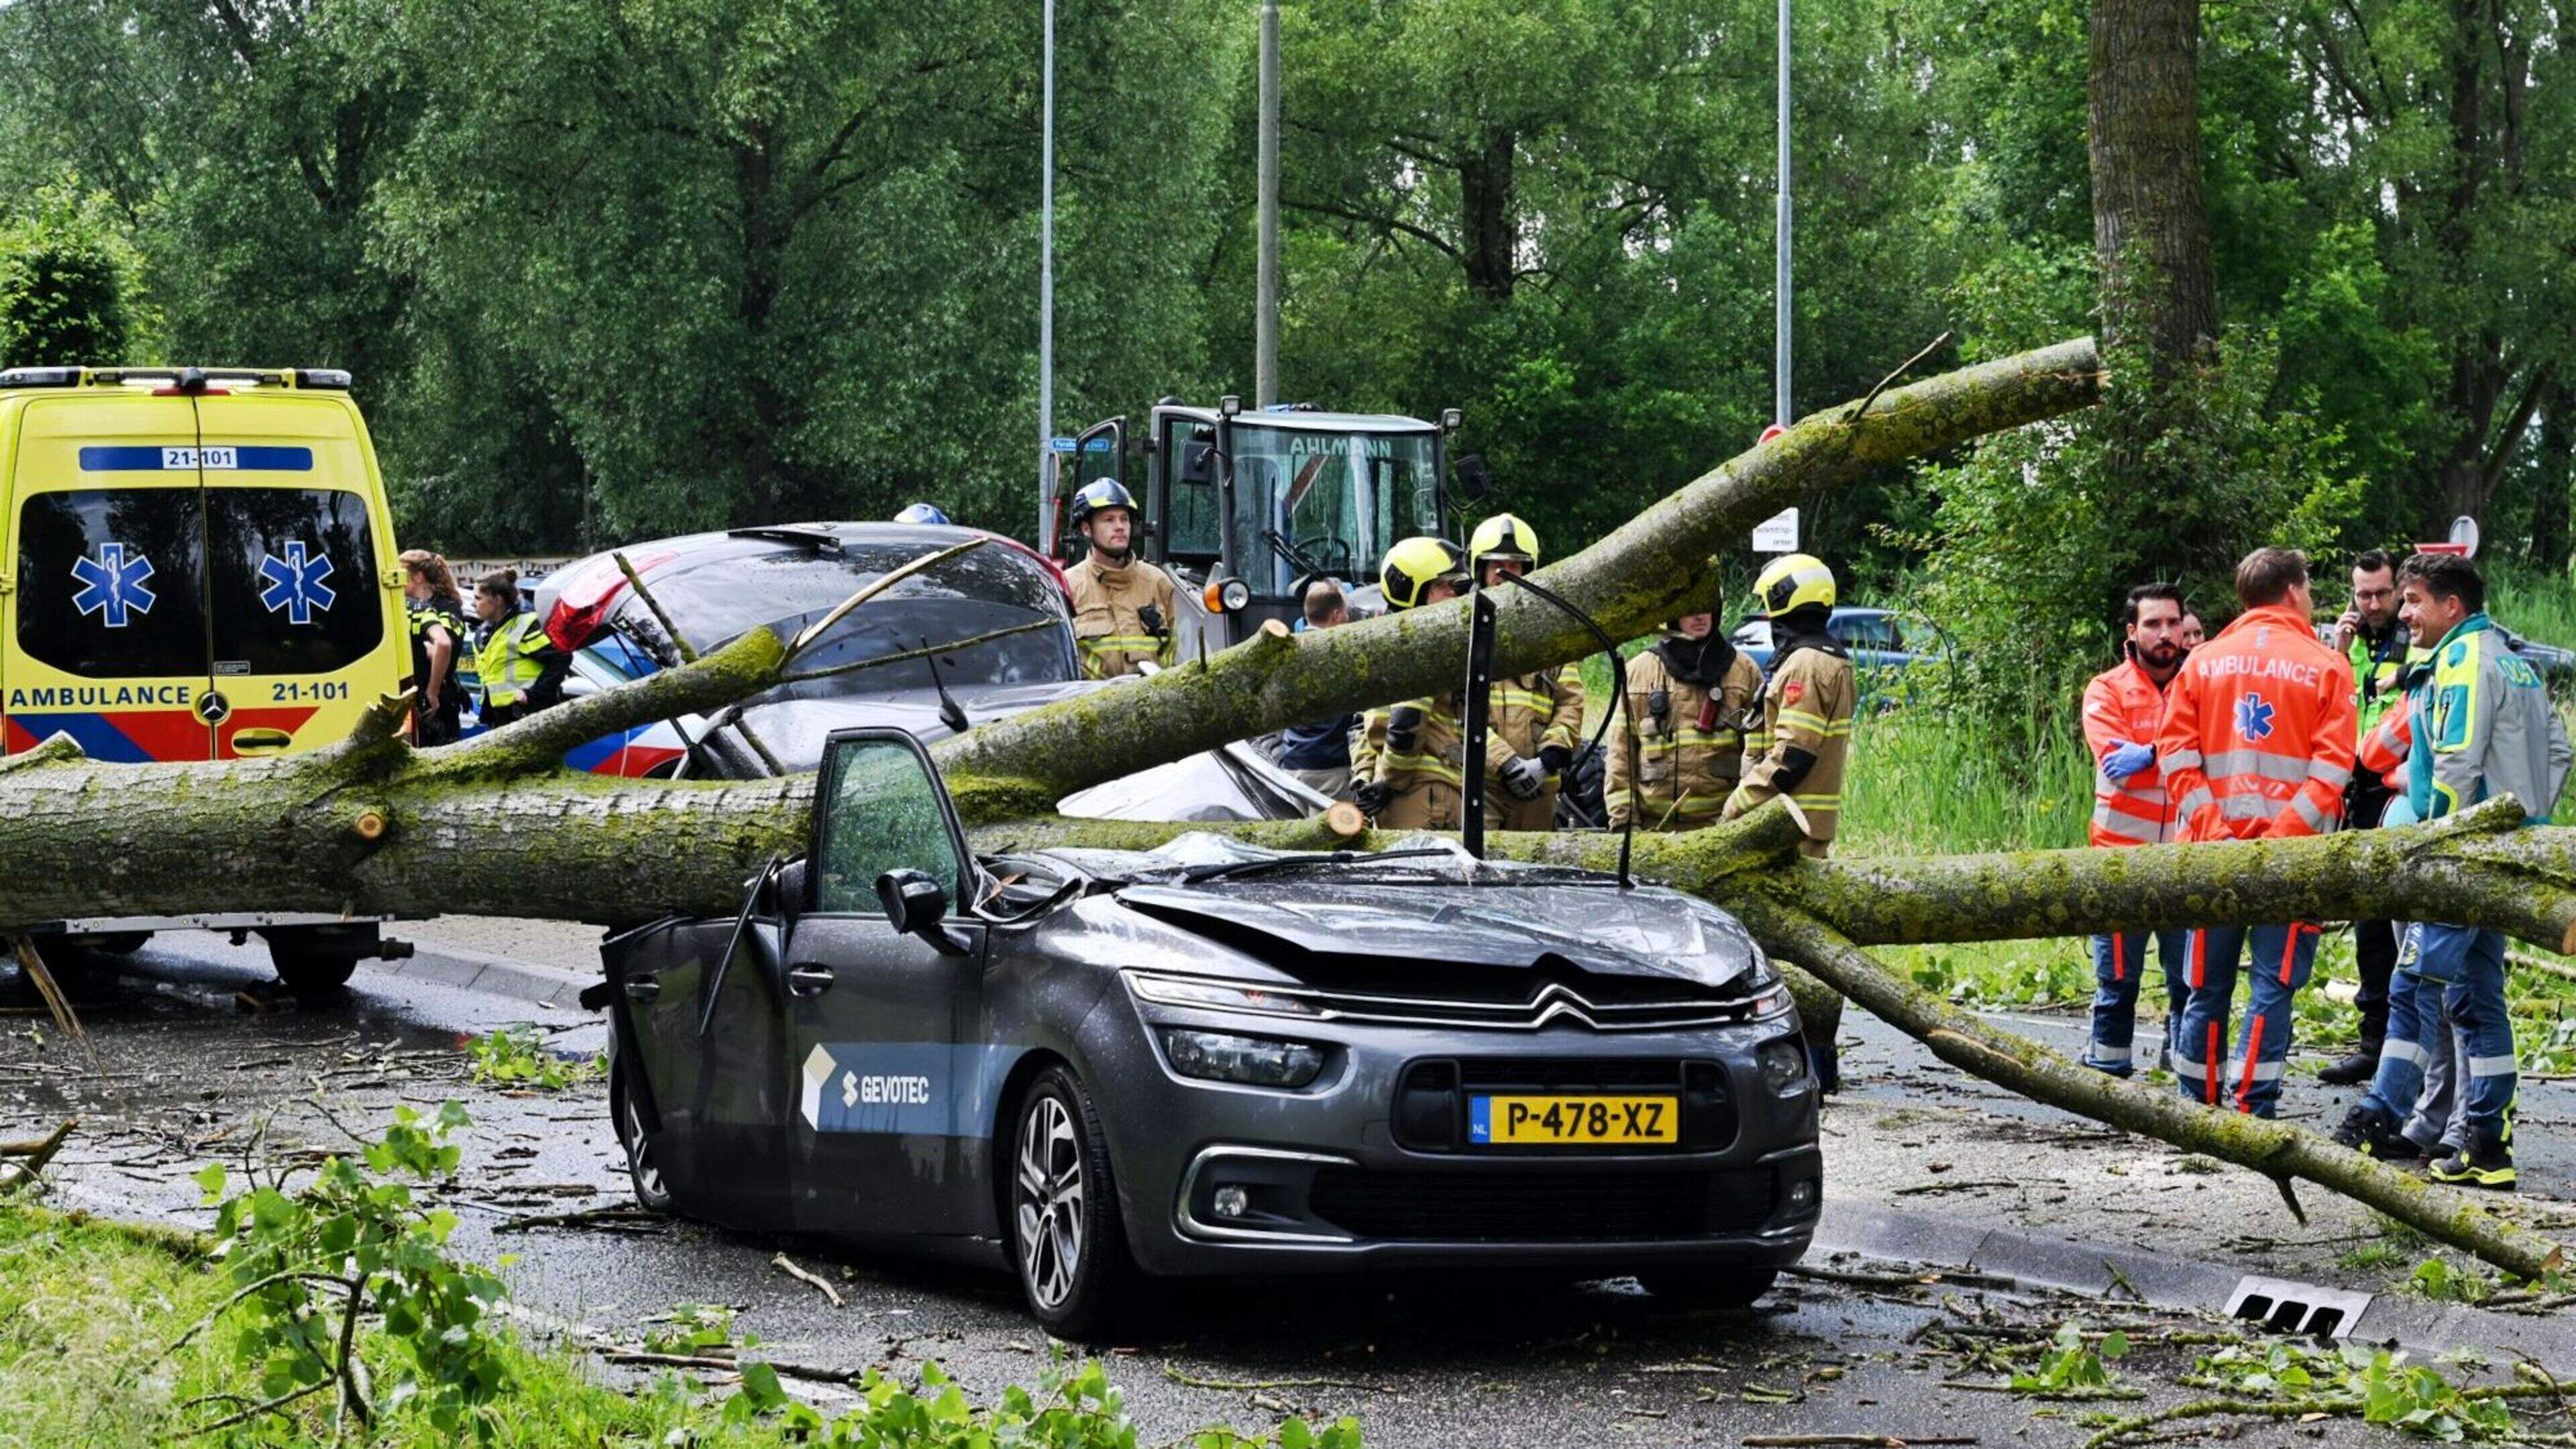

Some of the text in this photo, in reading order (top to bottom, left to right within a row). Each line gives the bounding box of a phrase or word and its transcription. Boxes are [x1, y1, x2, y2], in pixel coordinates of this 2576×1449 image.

[1289, 437, 1391, 458] AHLMANN
[168, 450, 231, 466] 21-101
[2198, 655, 2320, 687] AMBULANCE
[10, 686, 190, 706] AMBULANCE
[272, 682, 348, 701] 21-101
[861, 1075, 930, 1104] GEVOTEC
[1472, 1124, 1488, 1135] NL
[1508, 1102, 1664, 1137] P-478-XZ
